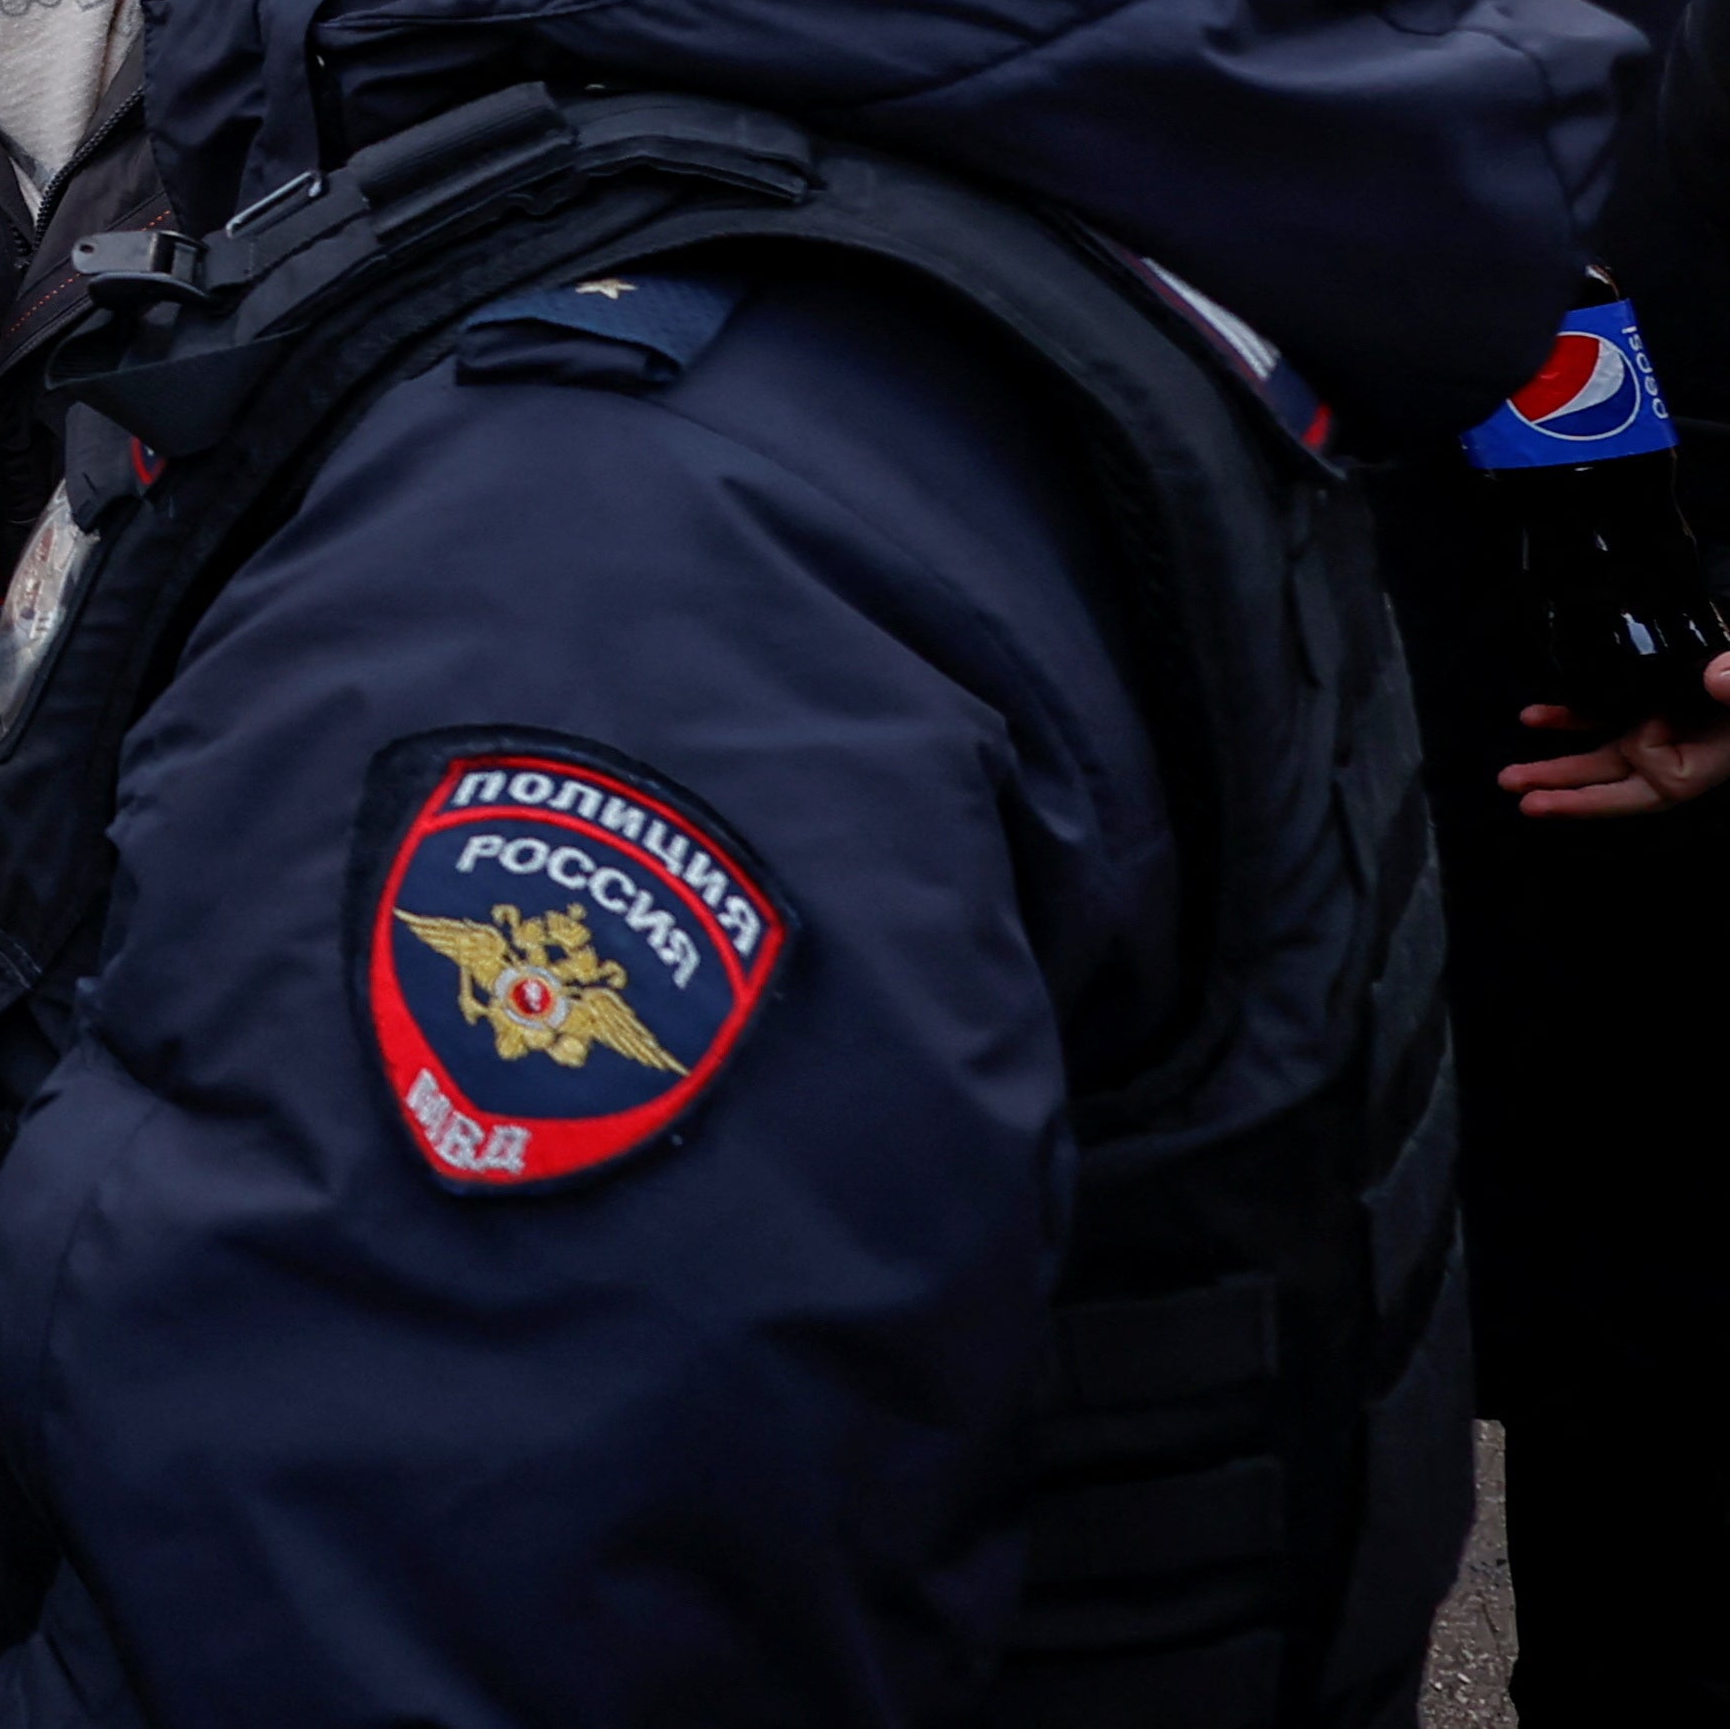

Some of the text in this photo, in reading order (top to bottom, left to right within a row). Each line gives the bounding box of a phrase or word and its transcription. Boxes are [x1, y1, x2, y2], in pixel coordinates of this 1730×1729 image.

[1621, 325, 1669, 420] pepsi
[453, 770, 762, 956] ПОЛИЦИЯ
[456, 834, 701, 988] РОССИЯ
[405, 1068, 532, 1174] МВД
